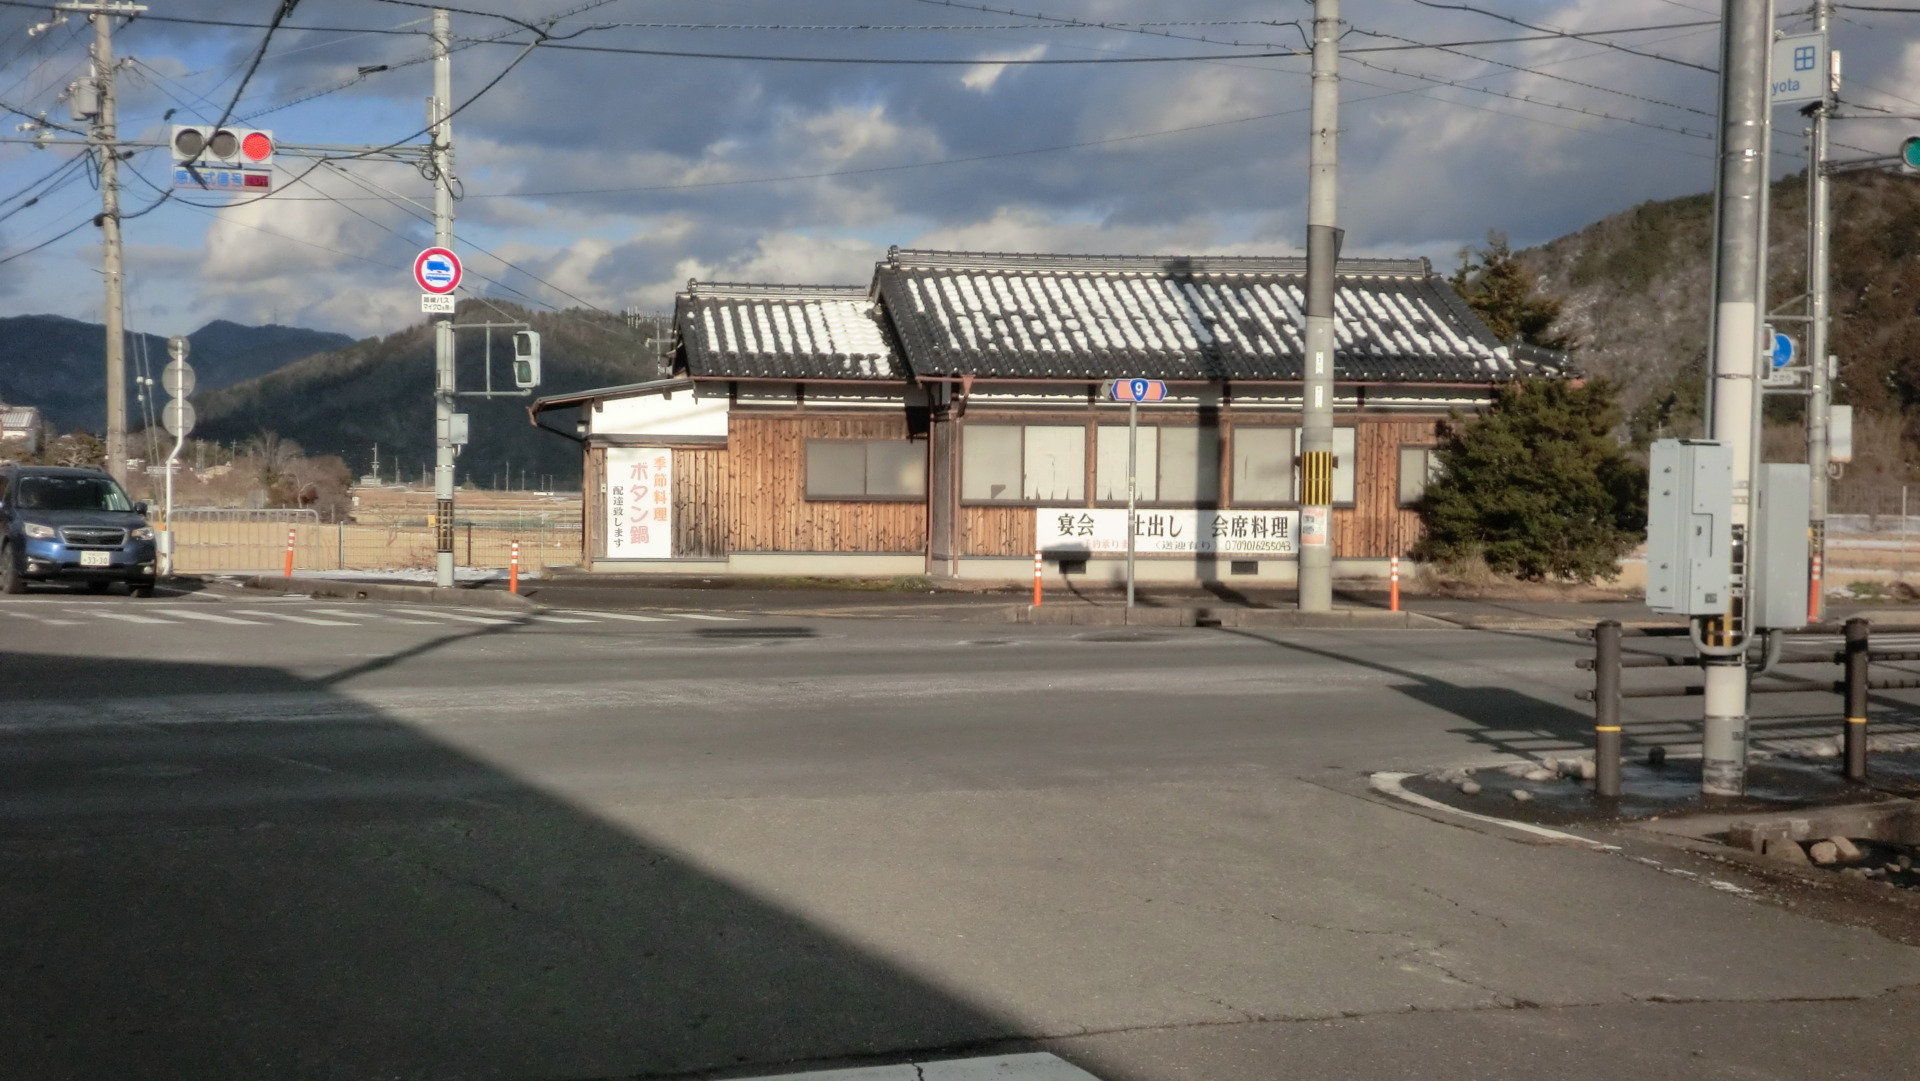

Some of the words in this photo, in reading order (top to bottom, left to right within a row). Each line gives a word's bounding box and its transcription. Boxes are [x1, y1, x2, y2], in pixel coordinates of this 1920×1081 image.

[1135, 382, 1144, 396] 9
[630, 462, 650, 545] ボタン鍋
[653, 456, 668, 522] 季節料理
[613, 485, 624, 548] 配達致します
[1057, 512, 1095, 537] 宴会
[1211, 514, 1289, 539] 会席料理
